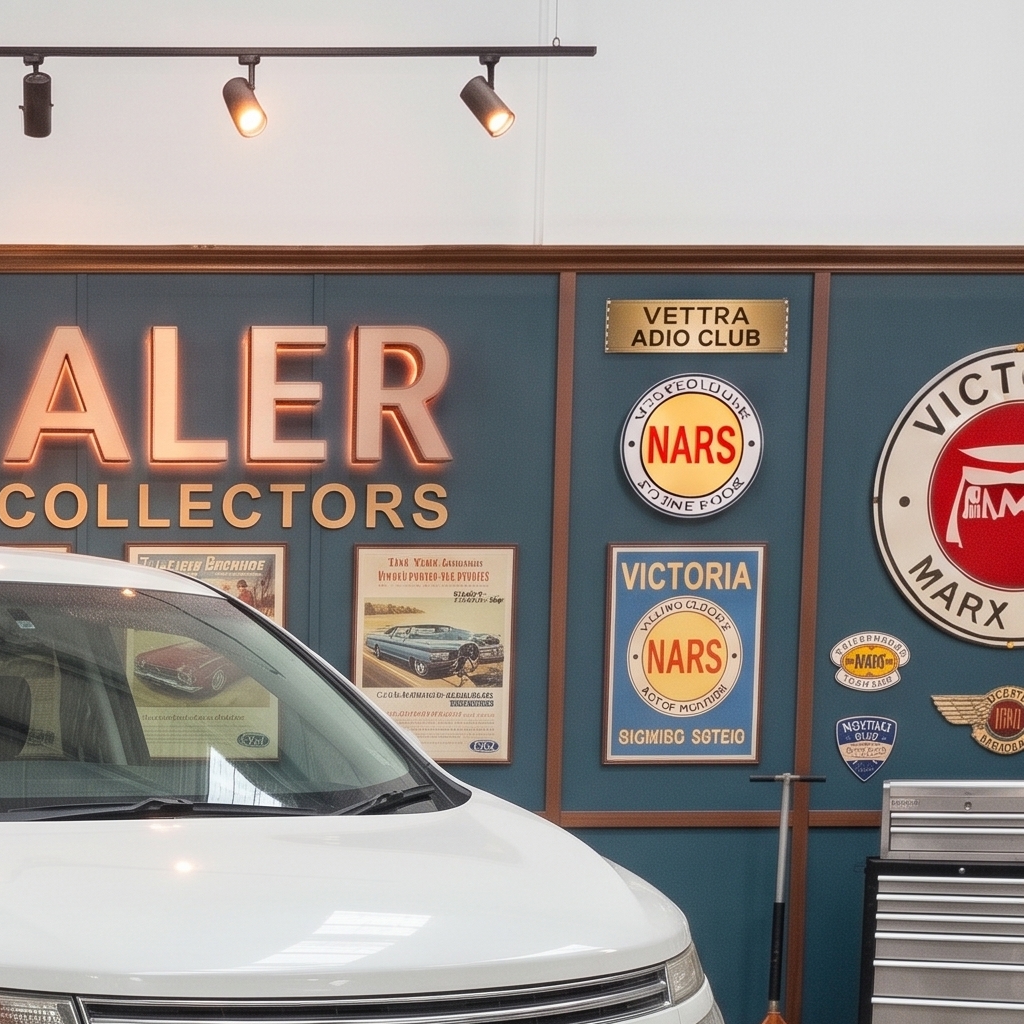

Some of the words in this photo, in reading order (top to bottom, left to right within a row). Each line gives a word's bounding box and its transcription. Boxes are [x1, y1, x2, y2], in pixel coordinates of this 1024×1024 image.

[643, 306, 750, 324] VETTRA
[631, 329, 690, 347] ADIO
[697, 329, 761, 347] CLUB
[912, 361, 1024, 436] VICT
[647, 425, 736, 465] NARS
[621, 562, 752, 590] VICTORIA
[908, 554, 1009, 630] MARX
[647, 638, 722, 674] NARS
